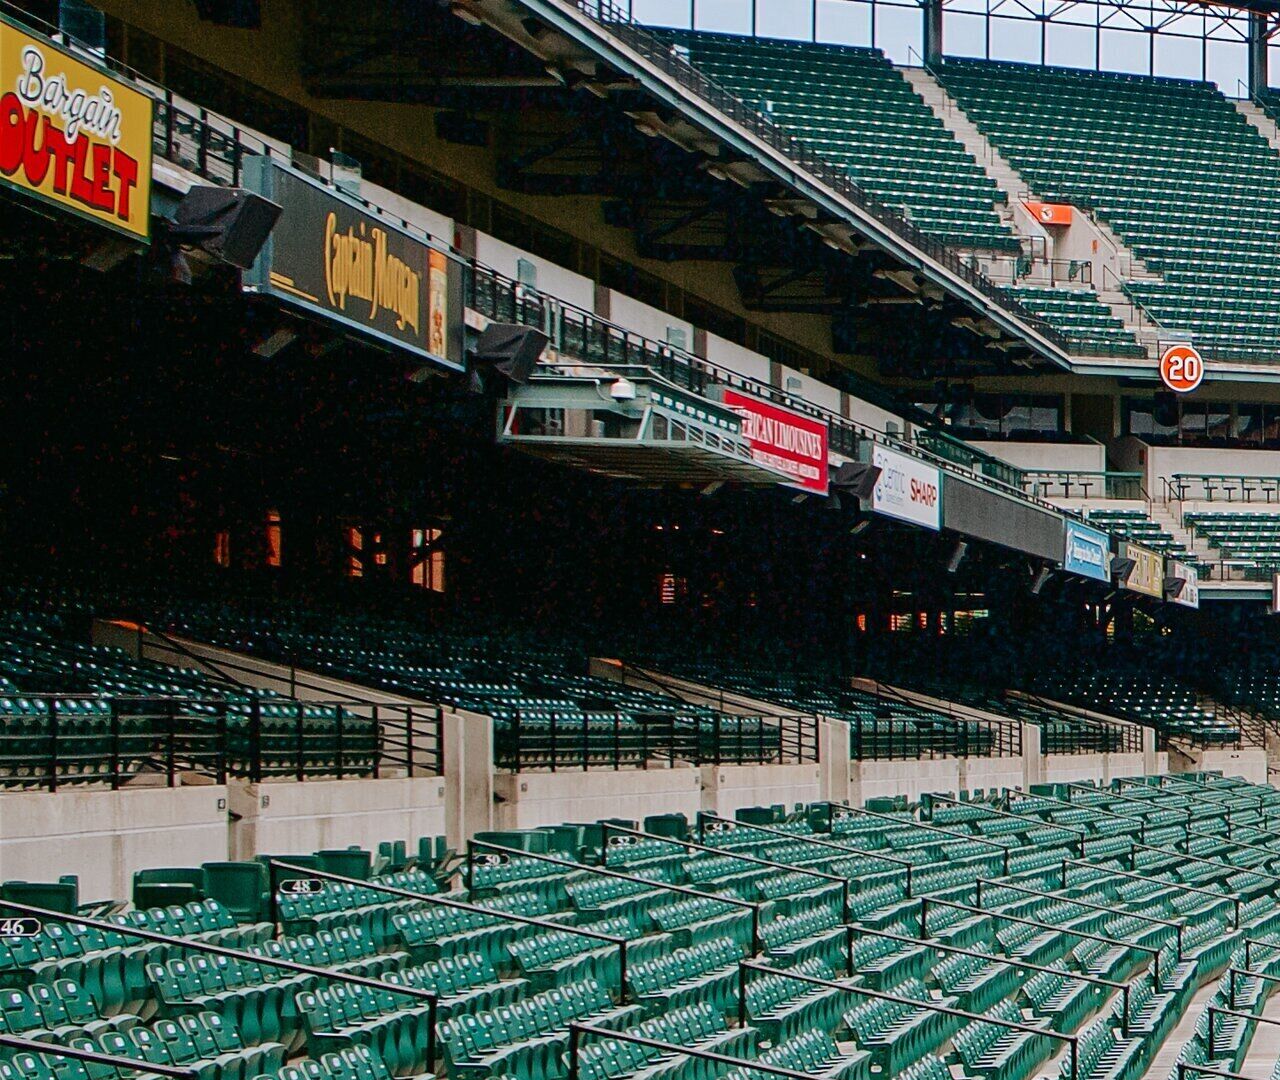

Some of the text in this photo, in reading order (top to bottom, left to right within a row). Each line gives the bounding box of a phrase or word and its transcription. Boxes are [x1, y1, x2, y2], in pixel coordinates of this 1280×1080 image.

[19, 46, 121, 143] Bargain
[0, 92, 138, 222] OUTLET
[325, 212, 420, 337] Captain Morgan
[1169, 355, 1198, 382] 20
[910, 477, 937, 508] SHARP
[486, 855, 500, 866] 50
[291, 880, 311, 893] 48
[1, 919, 25, 935] 46
